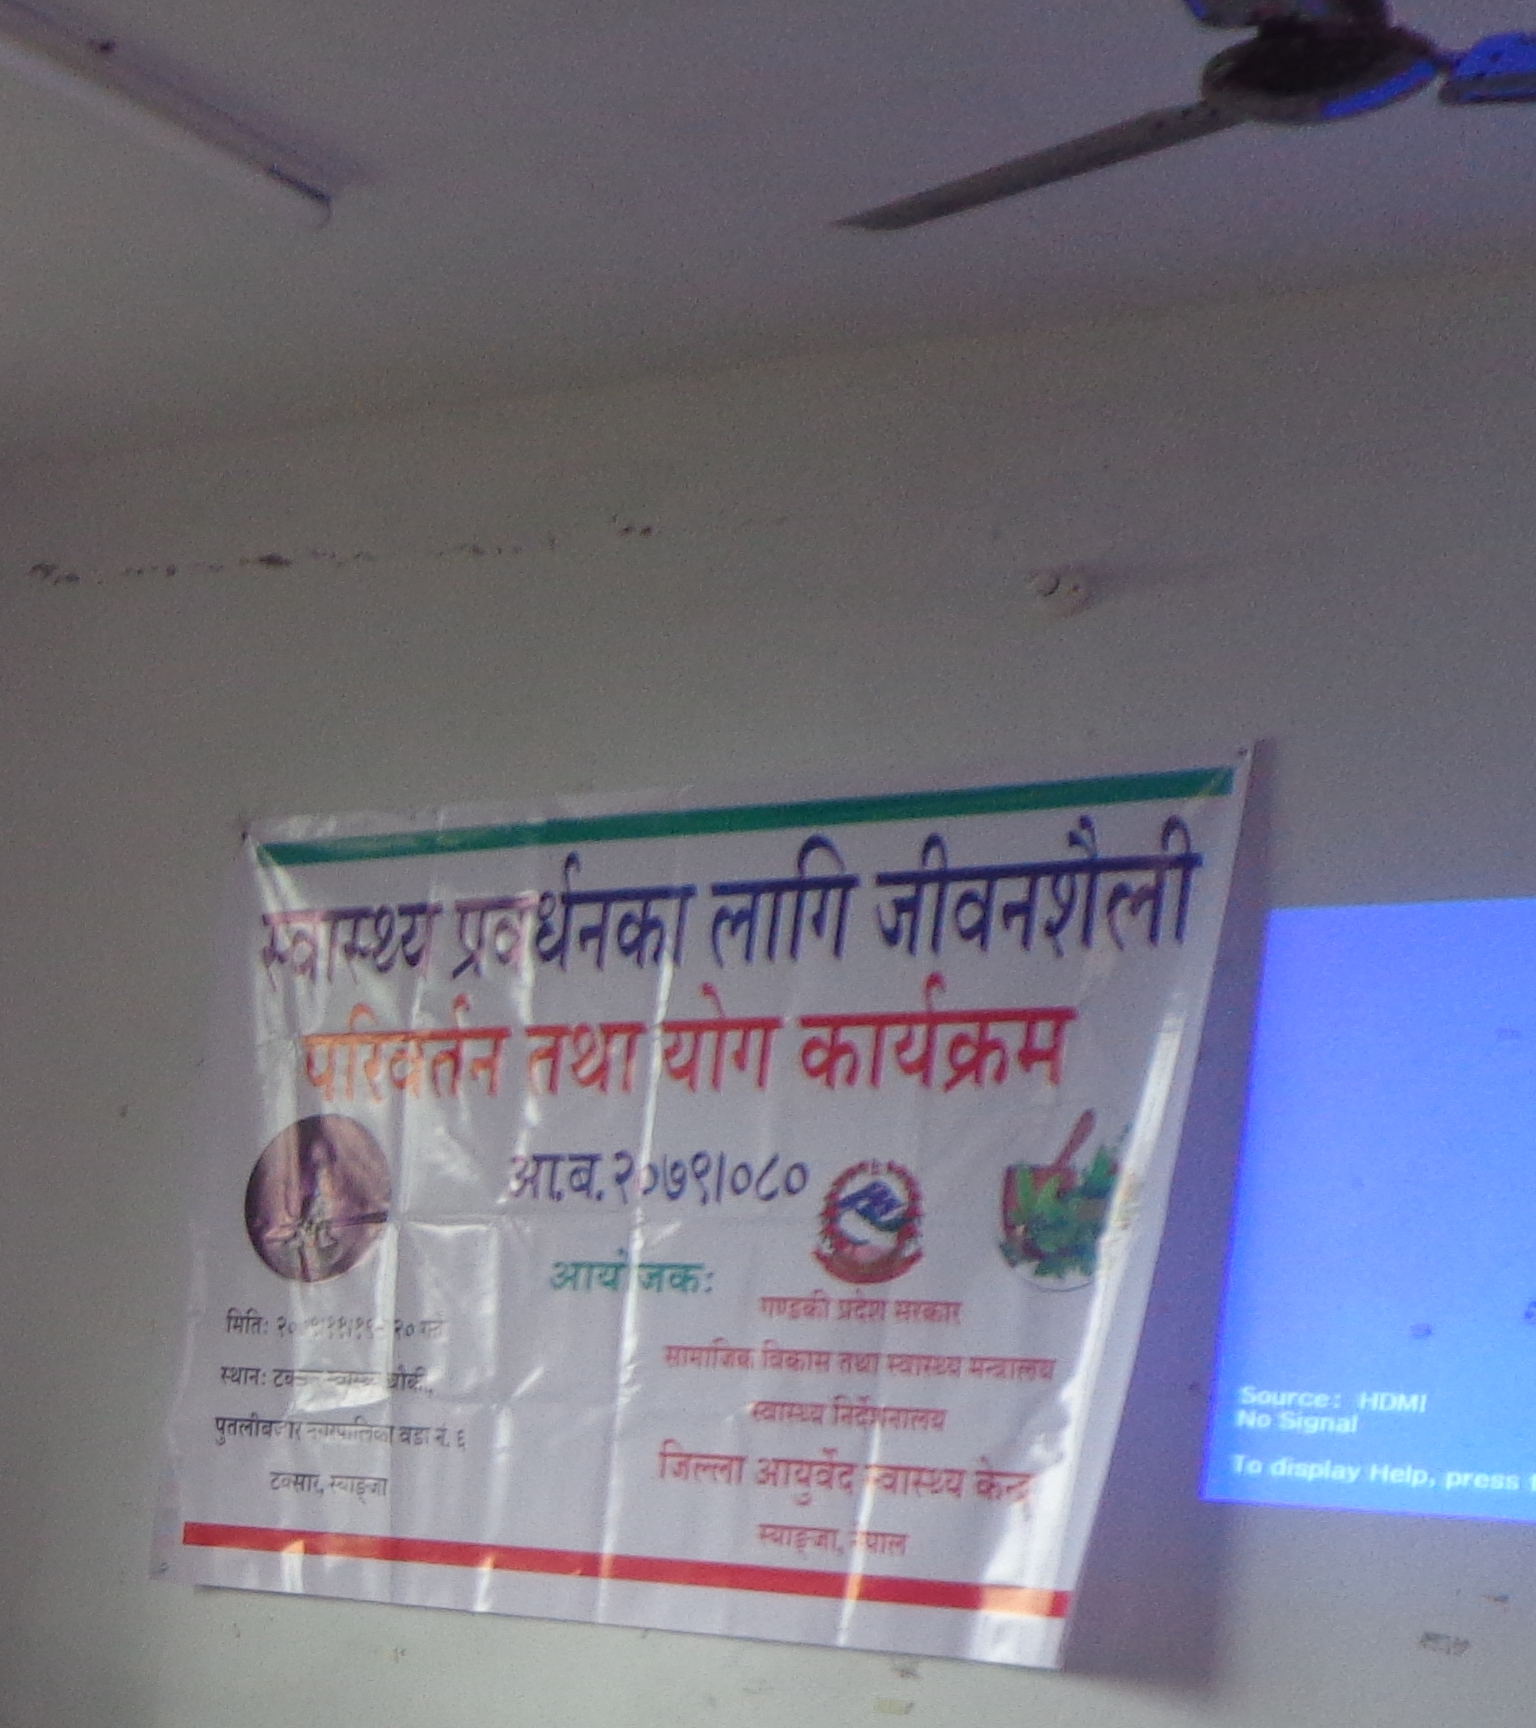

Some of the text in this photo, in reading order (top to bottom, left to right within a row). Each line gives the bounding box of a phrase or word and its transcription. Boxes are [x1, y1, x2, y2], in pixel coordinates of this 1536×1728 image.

[710, 833, 860, 967] लागि
[876, 814, 1204, 957] जीवनशैली
[302, 971, 1079, 1103] परिवर्तन तथा योग कार्यक्रम
[1239, 1385, 1427, 1414] Source: HDMI
[1236, 1409, 1359, 1434] No Signal
[1233, 1454, 1264, 1475] To
[1269, 1457, 1361, 1483] display
[1369, 1463, 1436, 1488] Help,
[1445, 1471, 1521, 1491] press
